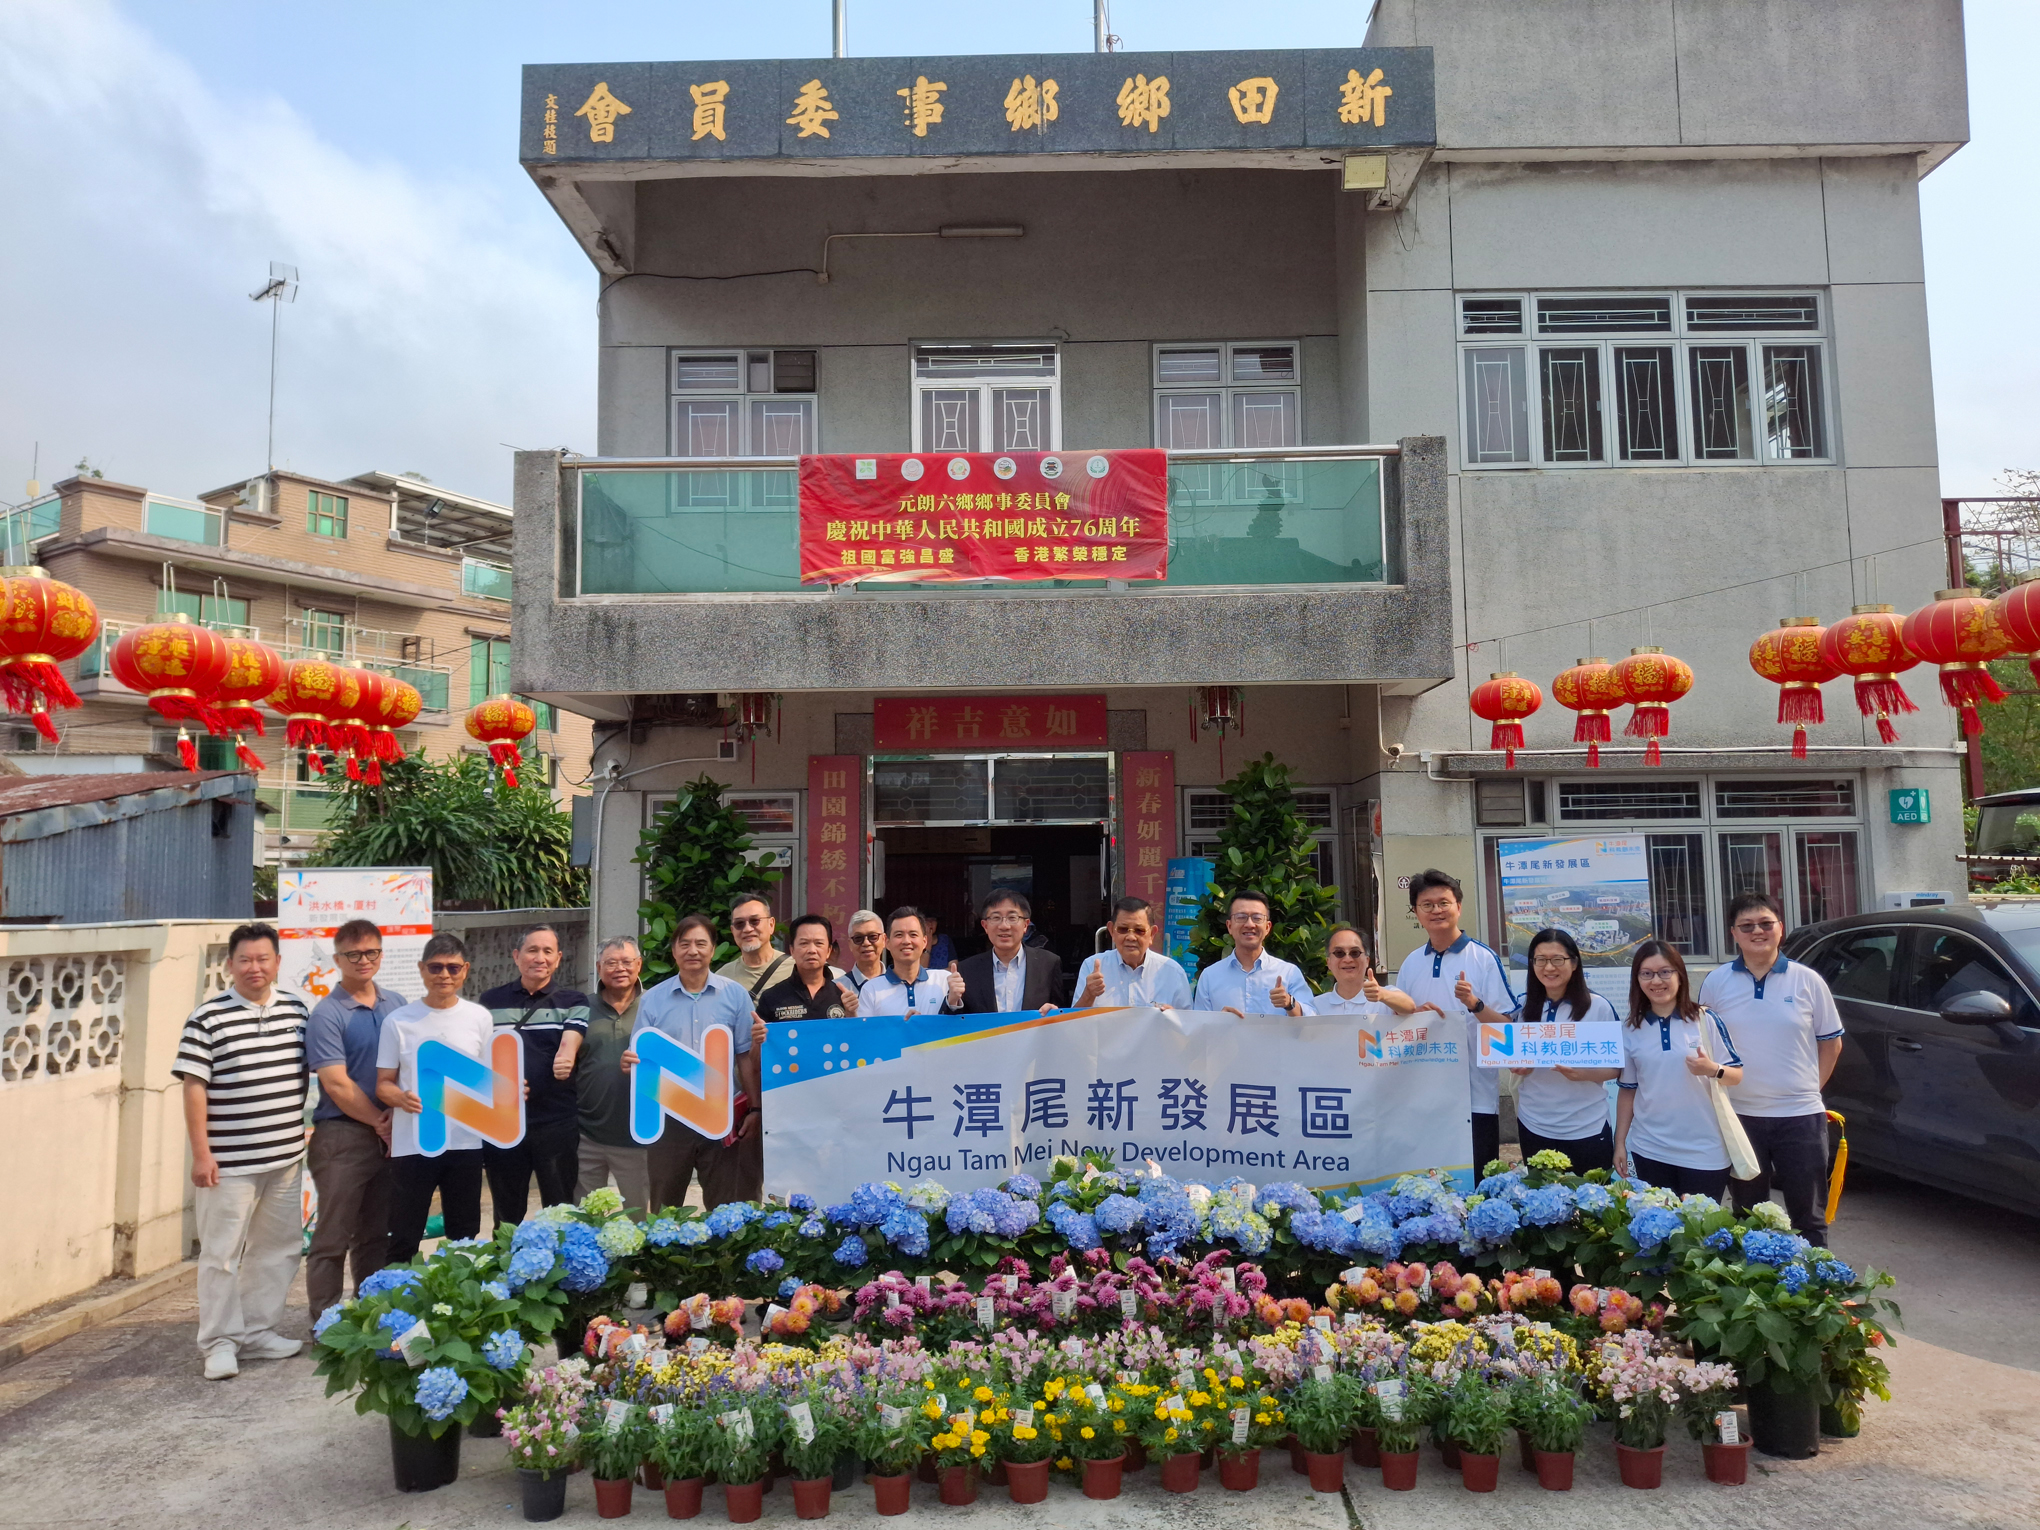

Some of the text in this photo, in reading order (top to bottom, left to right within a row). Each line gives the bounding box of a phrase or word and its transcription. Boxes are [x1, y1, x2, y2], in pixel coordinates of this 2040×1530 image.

[574, 68, 1393, 143] 新田鄉鄉事委員會
[898, 491, 1071, 513] 元朗六鄉鄉事委員會
[826, 516, 1141, 542] 慶祝中華人民共和國成立76周年
[840, 546, 1127, 565] 祖國富強昌盛 香港繁榮穩定
[904, 704, 1078, 740] 如意吉祥
[820, 770, 847, 940] 田園錦綉不朽
[1505, 858, 1591, 871] 牛潭尾新發展區
[1385, 1027, 1428, 1043] 牛潭尾
[1481, 1024, 1514, 1057] N
[1520, 1023, 1576, 1039] 牛潭尾
[1388, 1041, 1458, 1059] 科教創未來
[1521, 1040, 1619, 1056] 科教創未來
[1537, 1058, 1602, 1066] Tech-Knowledge
[882, 1077, 1353, 1140] 牛潭尾新發展區
[887, 1136, 1350, 1178] Ngau Tam Mei New Development Area
